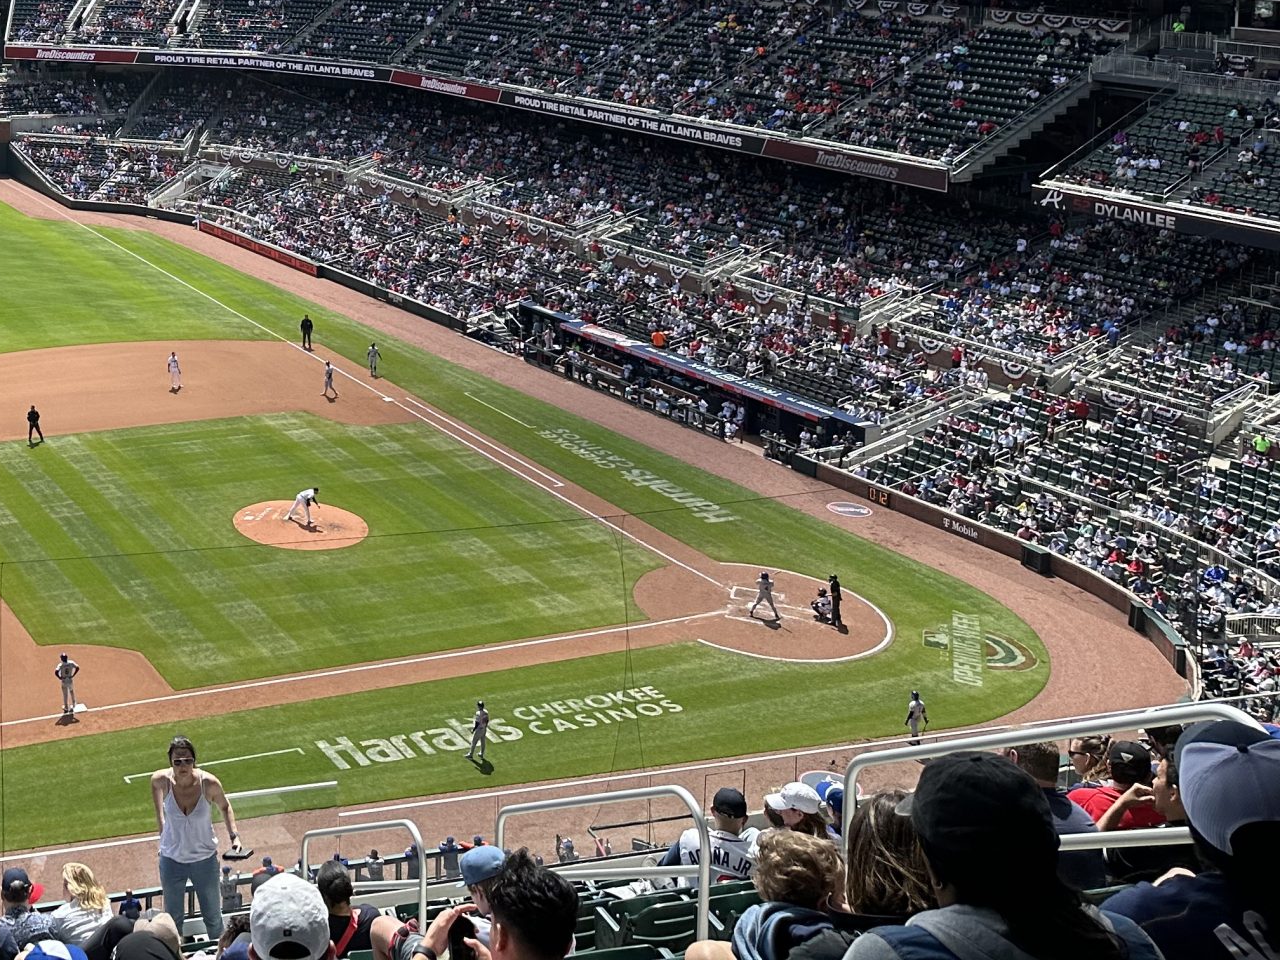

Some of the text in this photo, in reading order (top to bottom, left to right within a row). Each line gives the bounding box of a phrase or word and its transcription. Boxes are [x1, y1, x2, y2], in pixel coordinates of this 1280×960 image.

[154, 55, 375, 78] PROUD TIRE RETAIL PARTNER OF THE ATLANTA BRAVES
[515, 96, 742, 147] PROUD TIRE RETAIL PARTNER OF THE ATLANTA BRAVES
[1095, 202, 1176, 229] DYLAN LEE
[952, 520, 978, 538] Mobile
[513, 685, 666, 720] CHEROKEE
[529, 699, 683, 736] CASINOS
[688, 846, 730, 868] ACÑA
